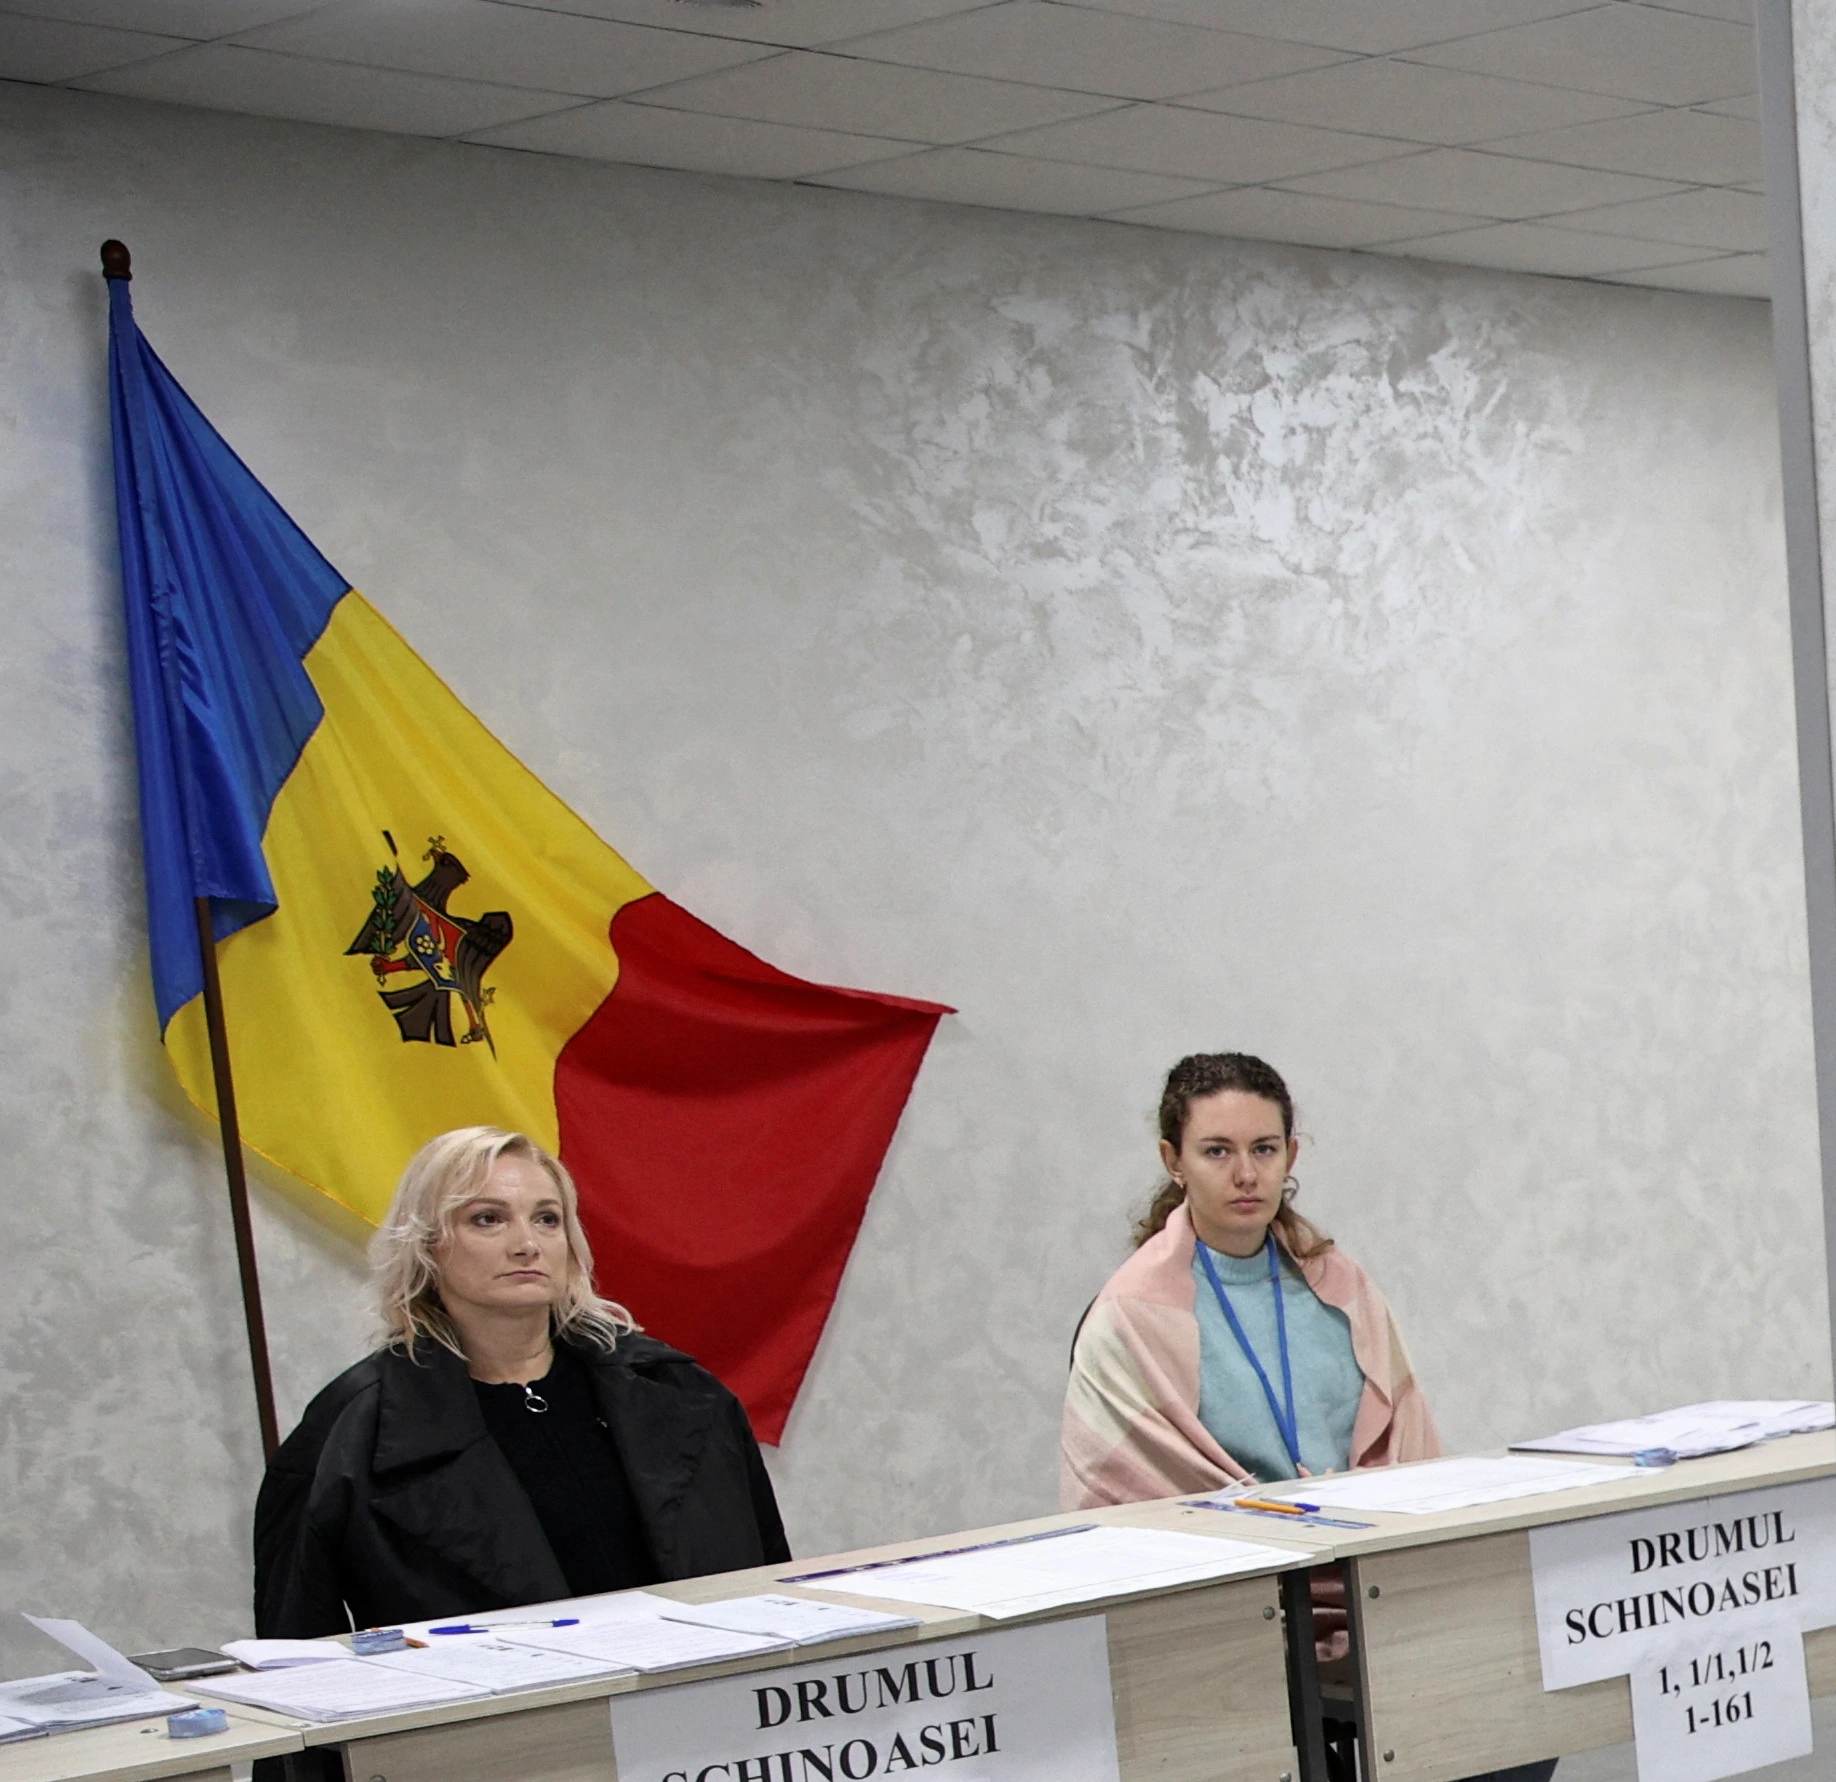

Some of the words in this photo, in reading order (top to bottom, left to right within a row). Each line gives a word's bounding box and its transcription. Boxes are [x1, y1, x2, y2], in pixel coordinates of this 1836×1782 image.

[1629, 1510, 1796, 1574] DRUMUL
[1565, 1562, 1800, 1645] SCHINOASEI
[752, 1651, 995, 1730] DRUMUL
[1659, 1666, 1681, 1697] 1,
[1685, 1691, 1755, 1735] 1-161
